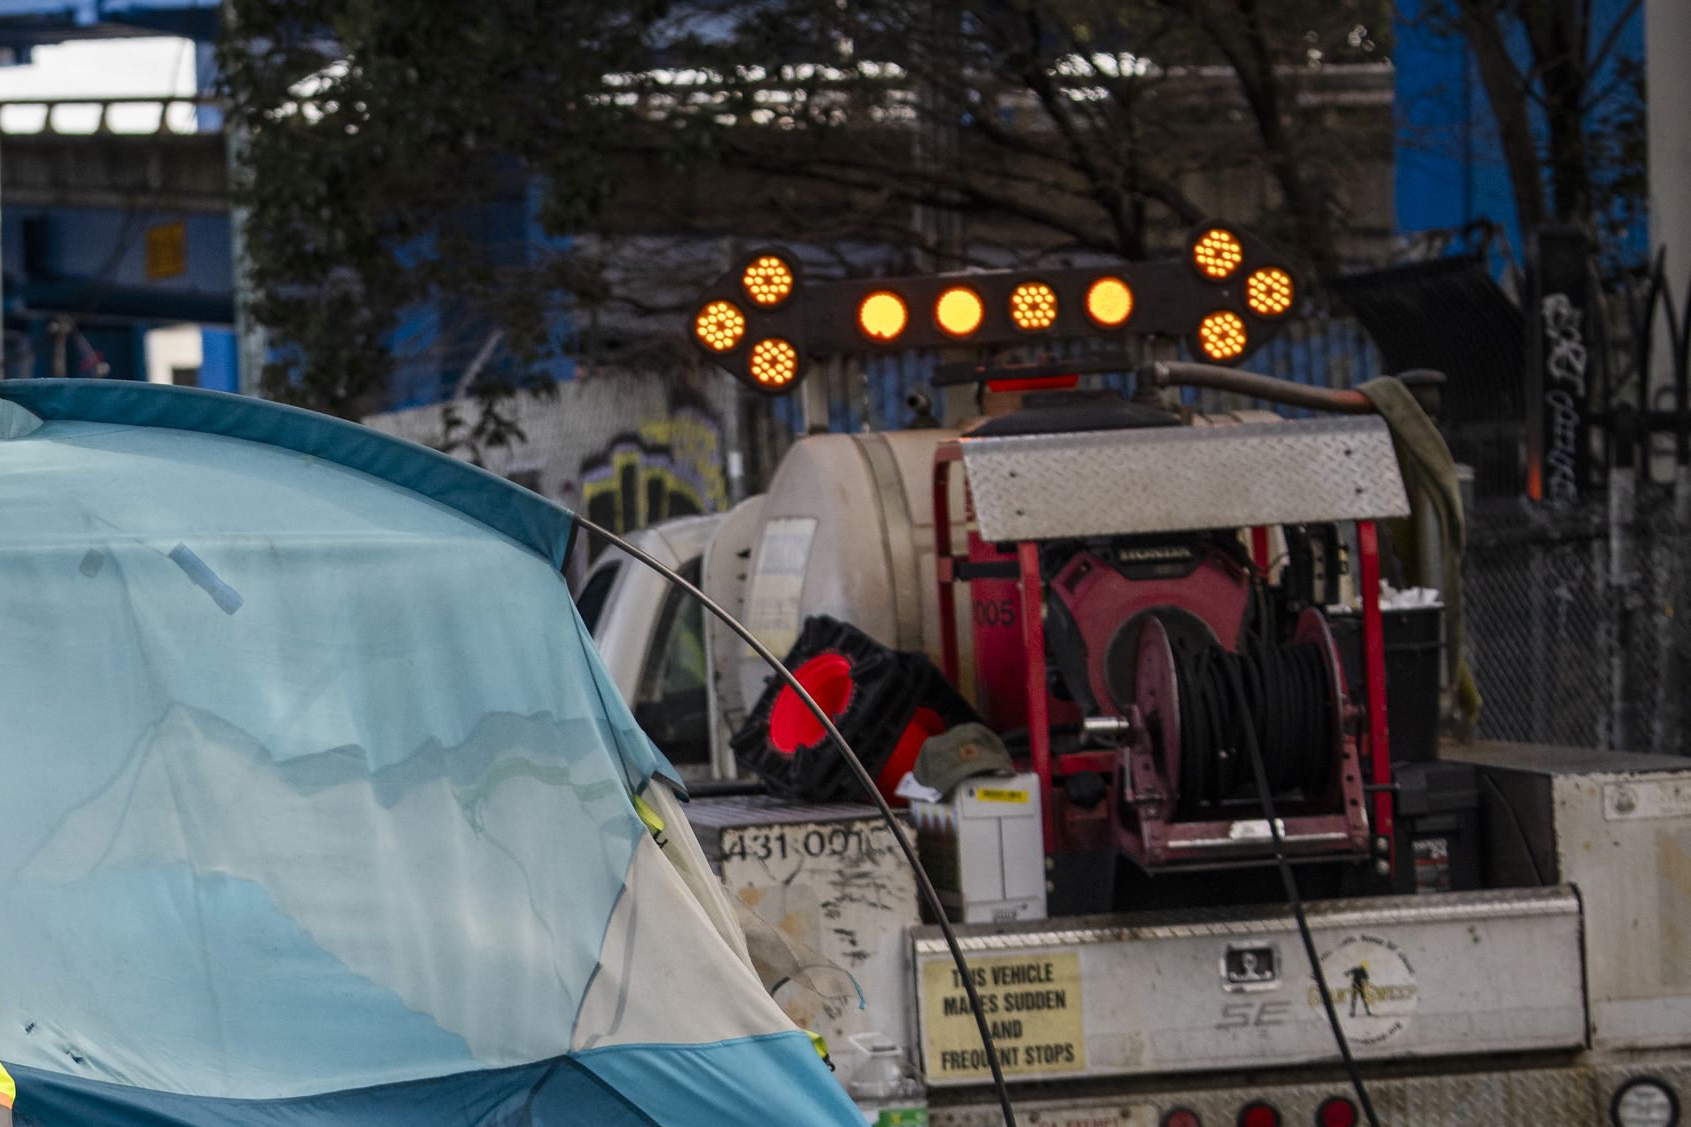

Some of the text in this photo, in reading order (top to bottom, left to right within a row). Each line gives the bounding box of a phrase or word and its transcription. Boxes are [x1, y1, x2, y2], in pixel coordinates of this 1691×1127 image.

[952, 962, 1053, 988] TIS VEHICLE
[943, 989, 1066, 1016] MAES SUDDEN
[992, 1019, 1022, 1040] AND
[941, 1042, 1075, 1071] FREQUNT STOPS
